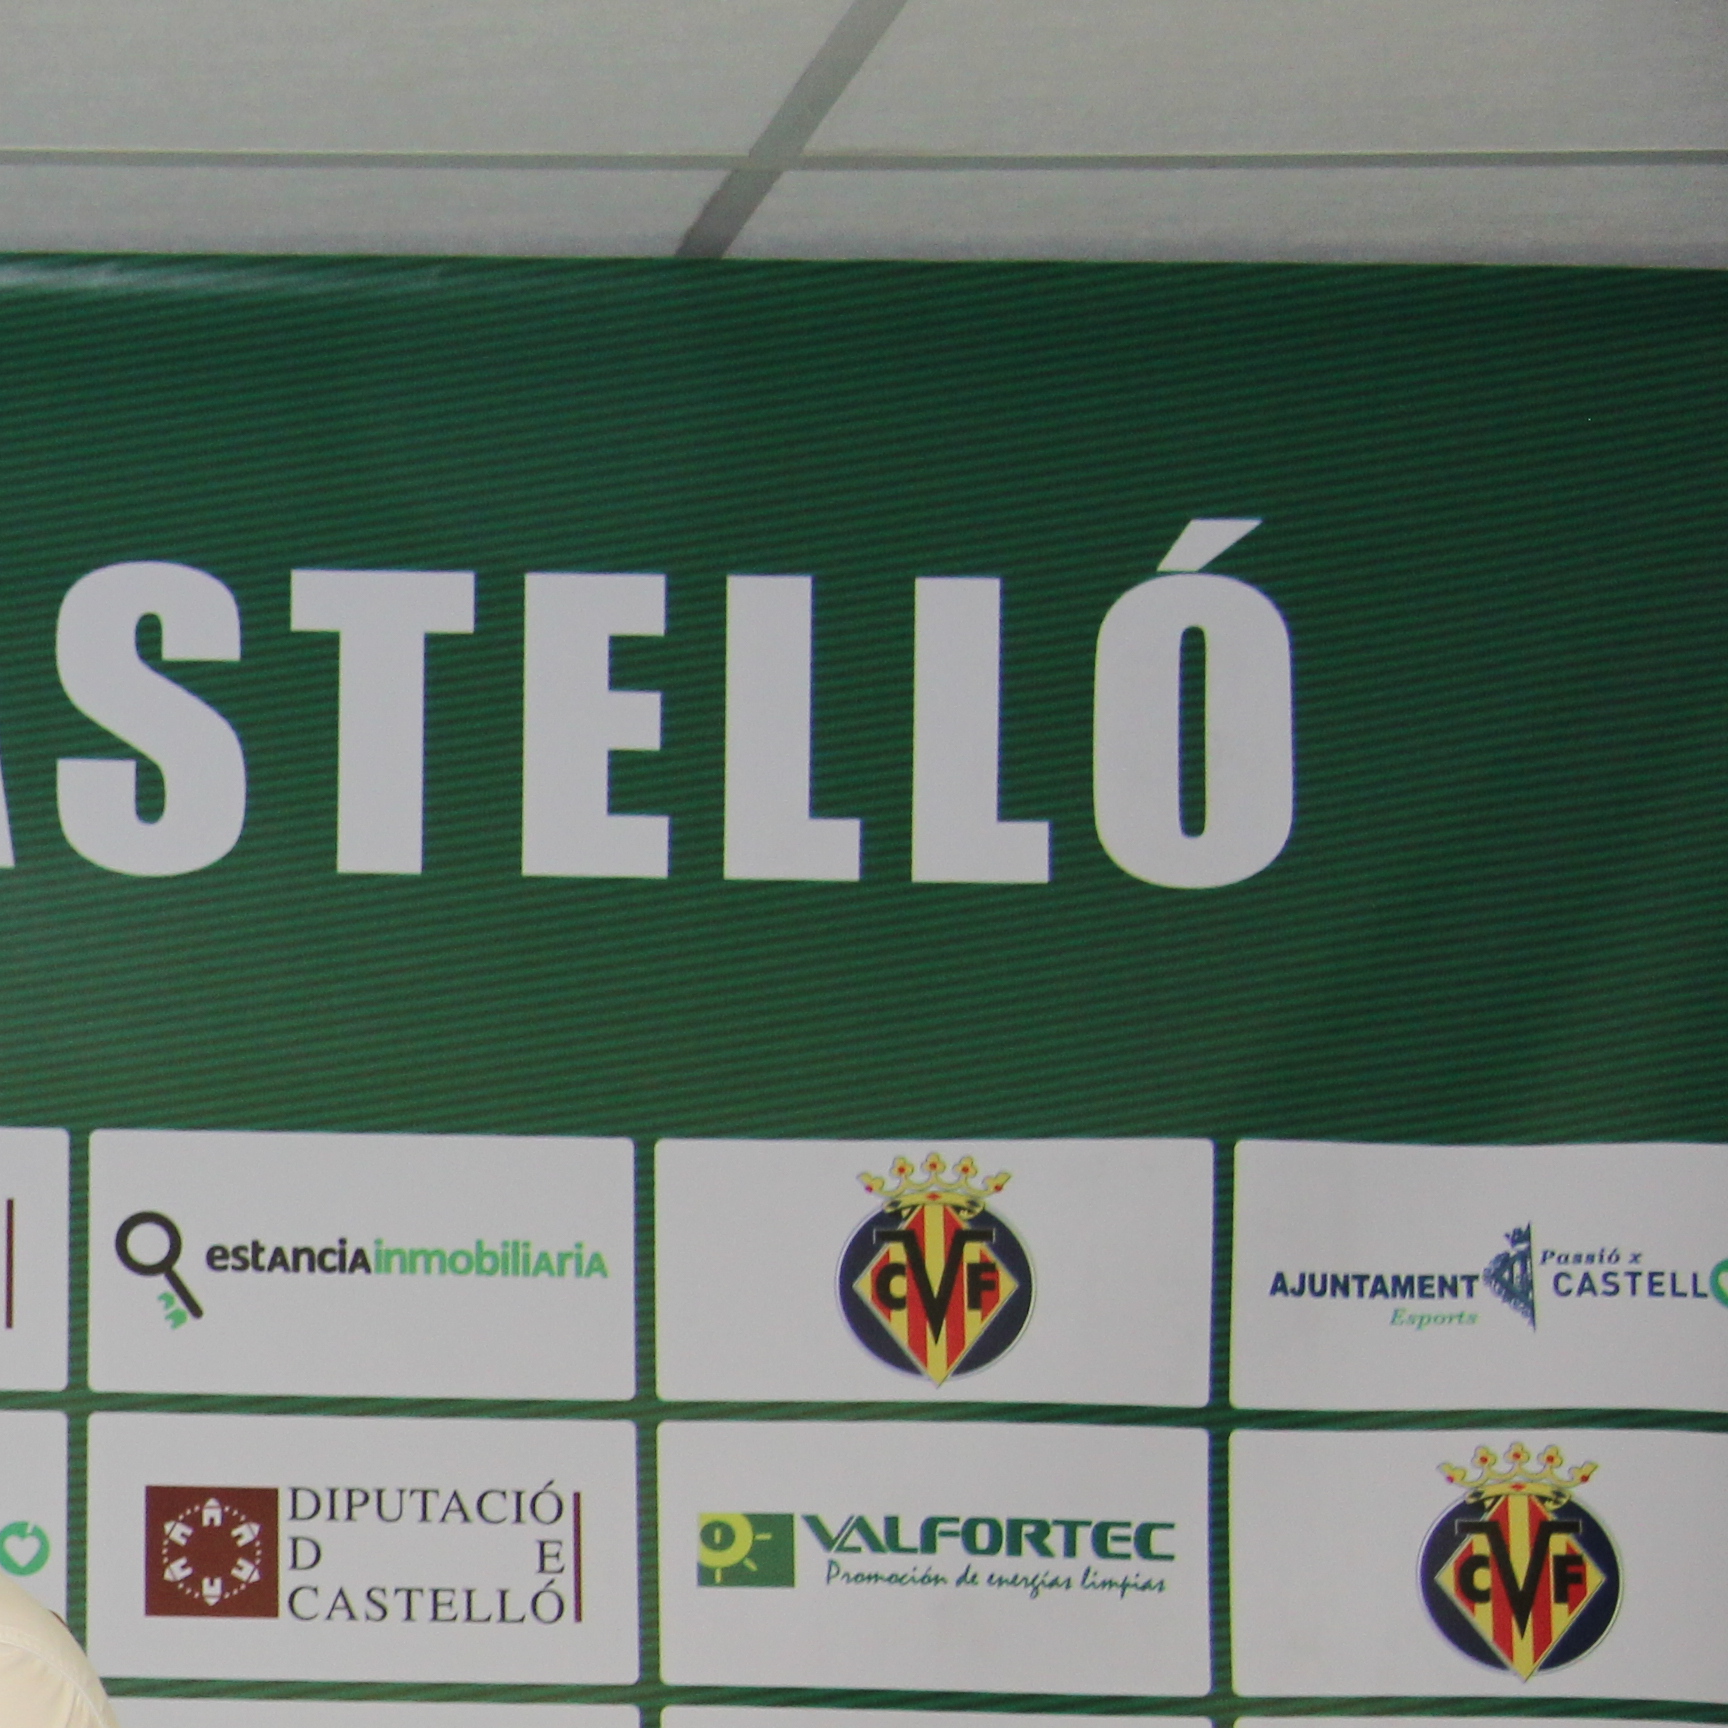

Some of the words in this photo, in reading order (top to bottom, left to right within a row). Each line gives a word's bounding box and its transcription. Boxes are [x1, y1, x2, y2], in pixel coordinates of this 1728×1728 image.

[1539, 1246, 1621, 1265] Passió
[1270, 1271, 1479, 1299] AJUNTAMENT
[1390, 1308, 1478, 1330] Esports
[290, 1480, 563, 1525] DIPUTACIÓ
[802, 1514, 1175, 1561] VALFORTEC
[826, 1559, 947, 1586] Promoción
[288, 1578, 564, 1624] CASTELLÓ
